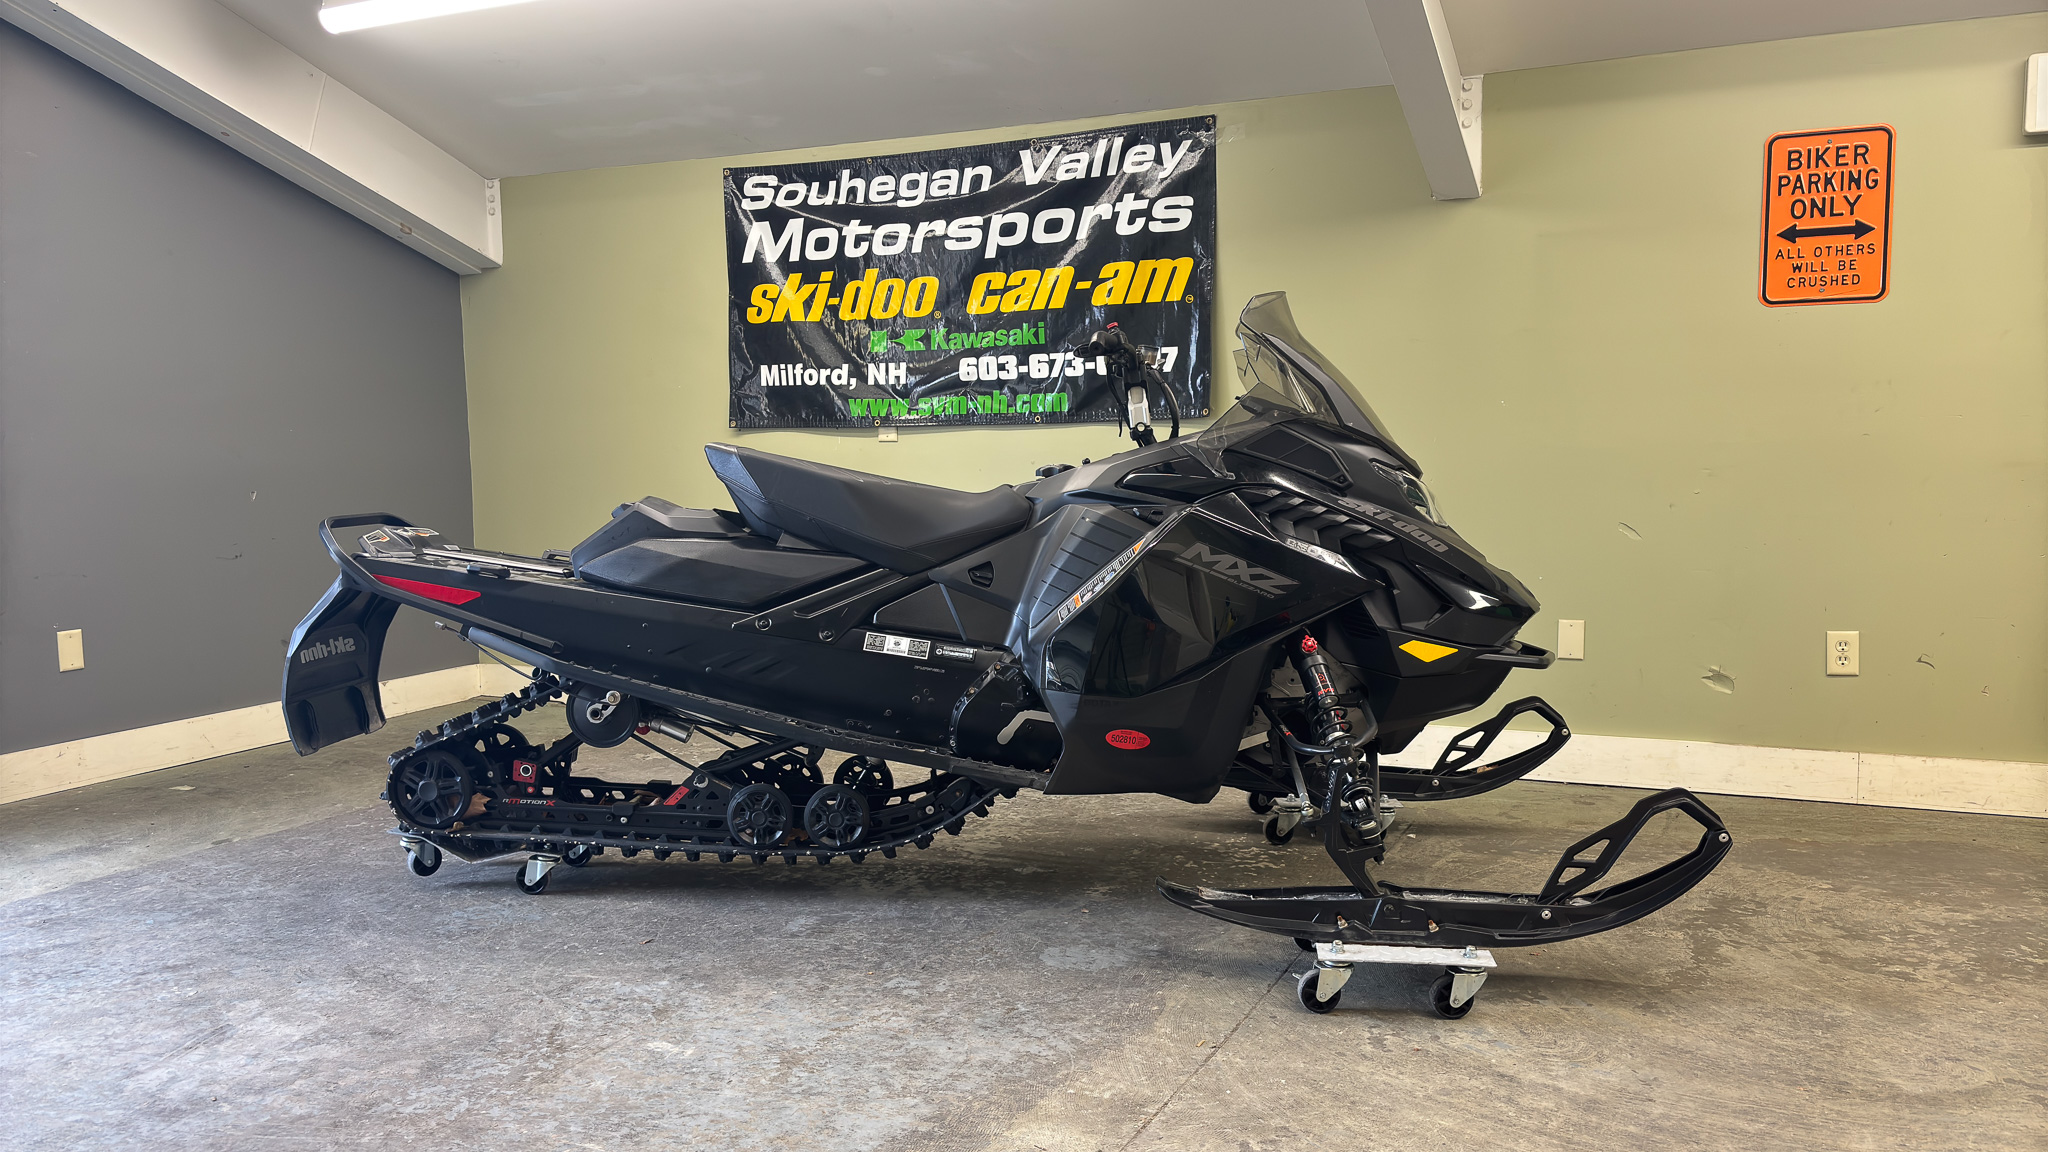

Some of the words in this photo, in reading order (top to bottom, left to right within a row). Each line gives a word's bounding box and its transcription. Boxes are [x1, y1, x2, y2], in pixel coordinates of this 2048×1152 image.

[1787, 143, 1870, 171] BIKER
[741, 162, 993, 211] Souhegan
[1019, 137, 1194, 187] Valley
[1778, 168, 1880, 196] PARKING
[1790, 193, 1863, 219] ONLY
[741, 193, 1195, 265] Motorsports
[1775, 248, 1805, 260] ALL
[1813, 243, 1876, 258] OTHERS
[1792, 261, 1829, 273] WILL
[1838, 259, 1857, 271] BE
[746, 268, 939, 324] ski-doo
[966, 256, 1195, 316] can-am
[1787, 274, 1861, 288] CRUSHED
[930, 324, 1046, 352] Kawasaki
[760, 363, 857, 390] Milford,
[867, 362, 907, 386] NH
[958, 347, 1179, 382] 603-673-7
[848, 390, 1068, 418] www.svm-nh.com
[1337, 499, 1450, 554] ski-doo
[1180, 542, 1300, 595] MXZ
[1110, 734, 1137, 745] 502810
